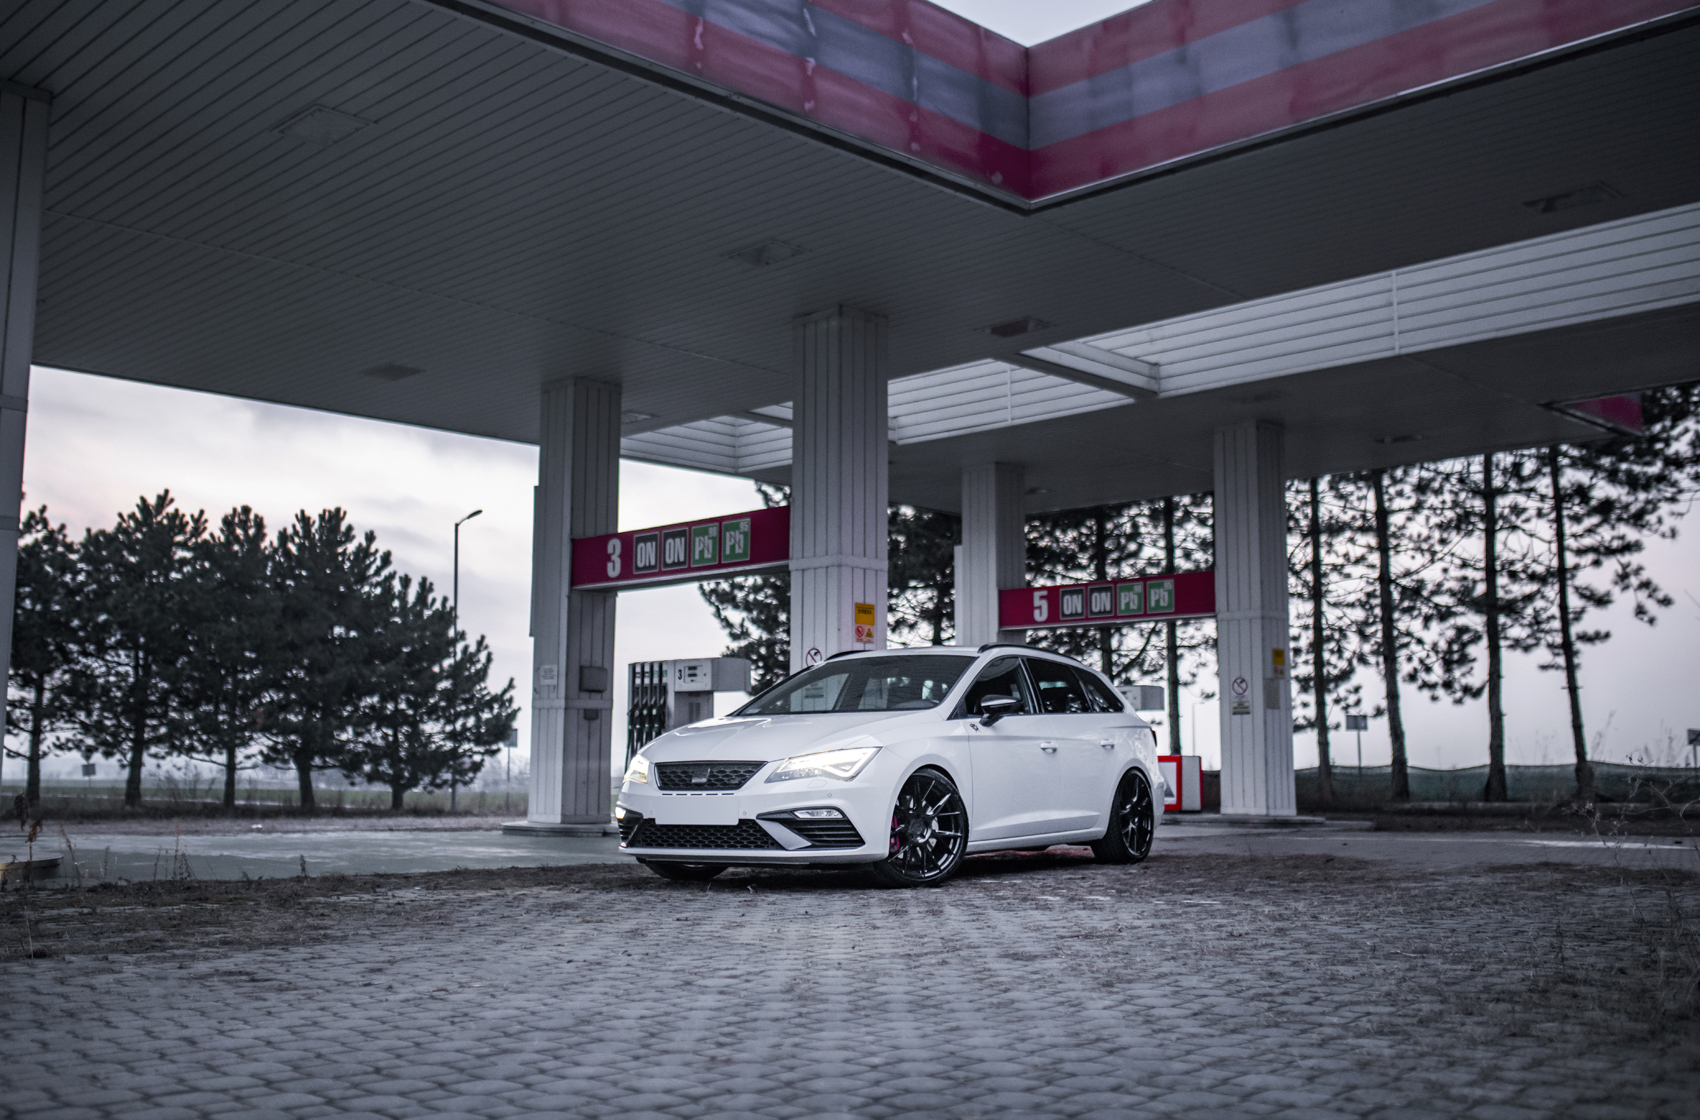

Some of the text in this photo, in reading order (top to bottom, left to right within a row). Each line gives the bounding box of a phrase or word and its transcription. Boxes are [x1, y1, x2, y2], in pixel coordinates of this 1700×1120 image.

[607, 538, 621, 578] 3
[636, 541, 656, 568] ON
[664, 537, 685, 564] ON
[1033, 590, 1049, 622] 5
[1063, 594, 1082, 615] ON
[1091, 592, 1111, 613] ON
[677, 669, 683, 680] 3
